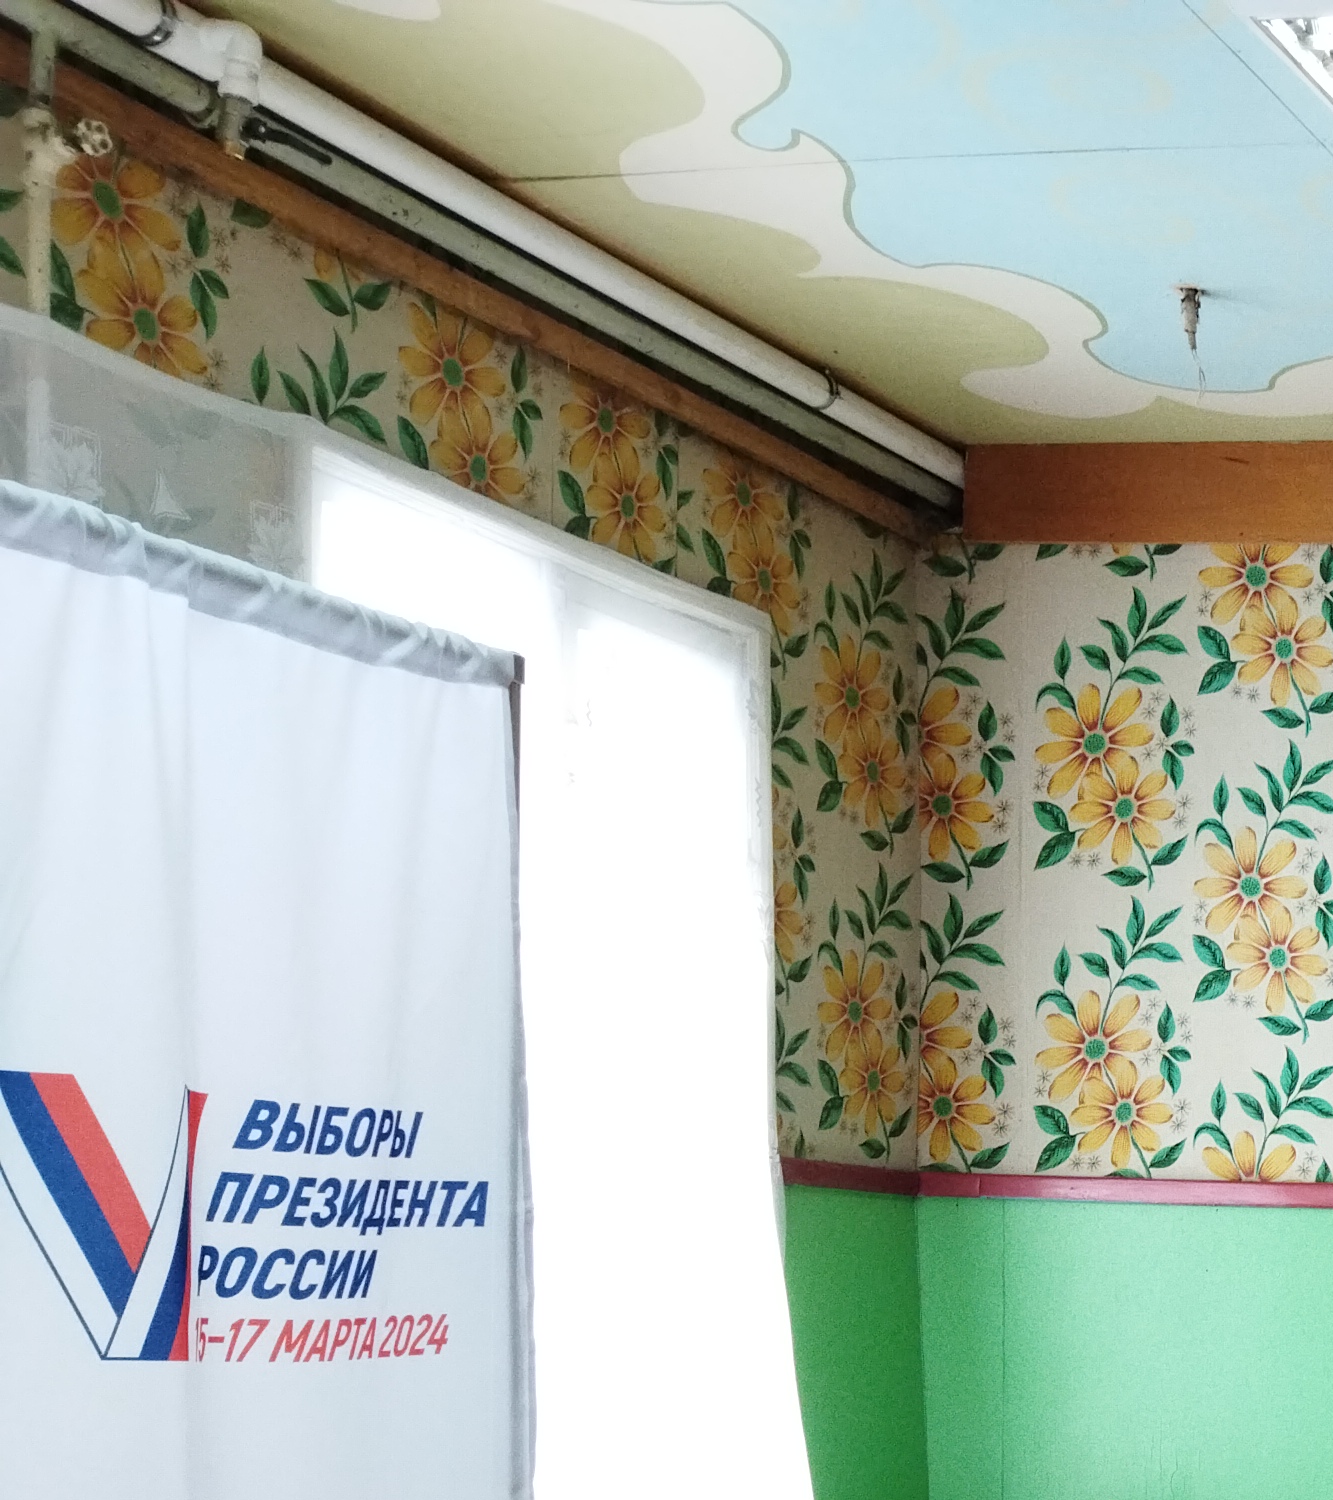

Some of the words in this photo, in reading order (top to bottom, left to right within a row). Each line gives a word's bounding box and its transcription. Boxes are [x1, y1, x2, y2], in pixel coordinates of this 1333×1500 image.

[232, 1100, 423, 1158] ВЫБОРЫ
[206, 1172, 488, 1236] ПРЕЗИДЕНТА
[197, 1245, 377, 1300] РОССИИ
[269, 1317, 377, 1362] МАРТА
[378, 1314, 448, 1358] 2024
